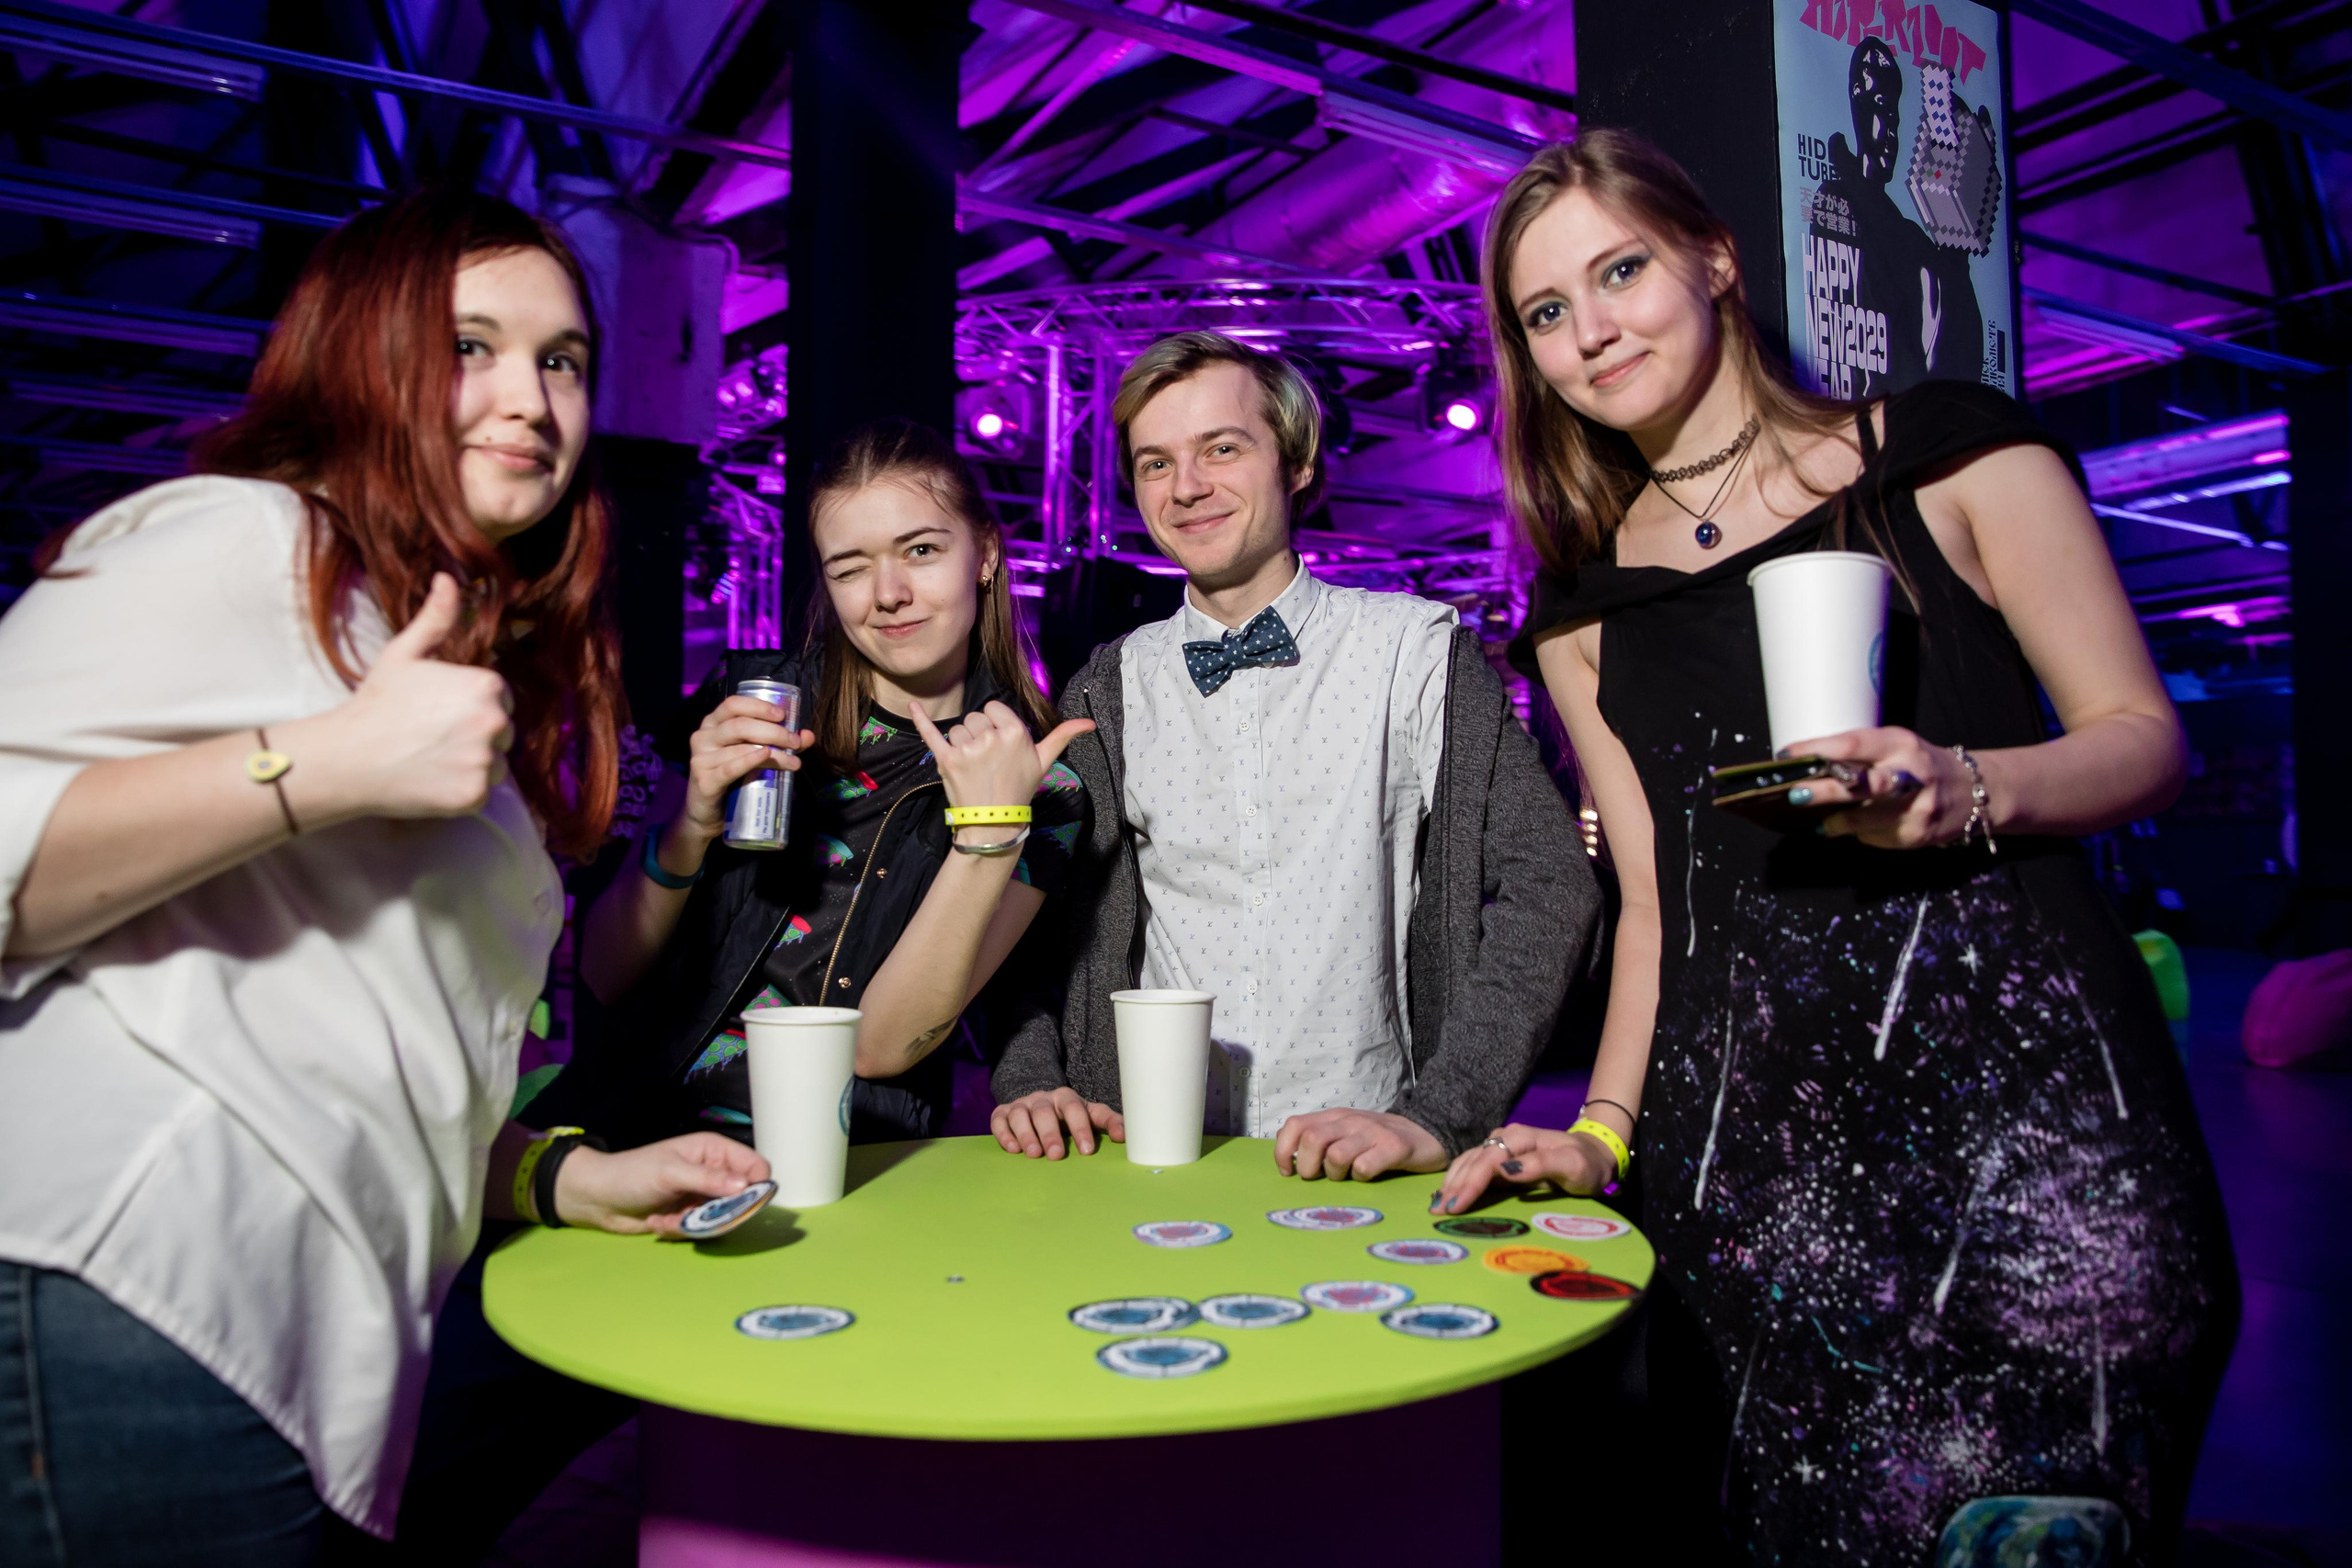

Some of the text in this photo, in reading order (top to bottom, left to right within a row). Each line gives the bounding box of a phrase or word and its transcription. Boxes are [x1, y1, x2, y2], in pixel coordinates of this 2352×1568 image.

[1799, 186, 1850, 217] 天才が必
[1801, 232, 1860, 307] HAPPY
